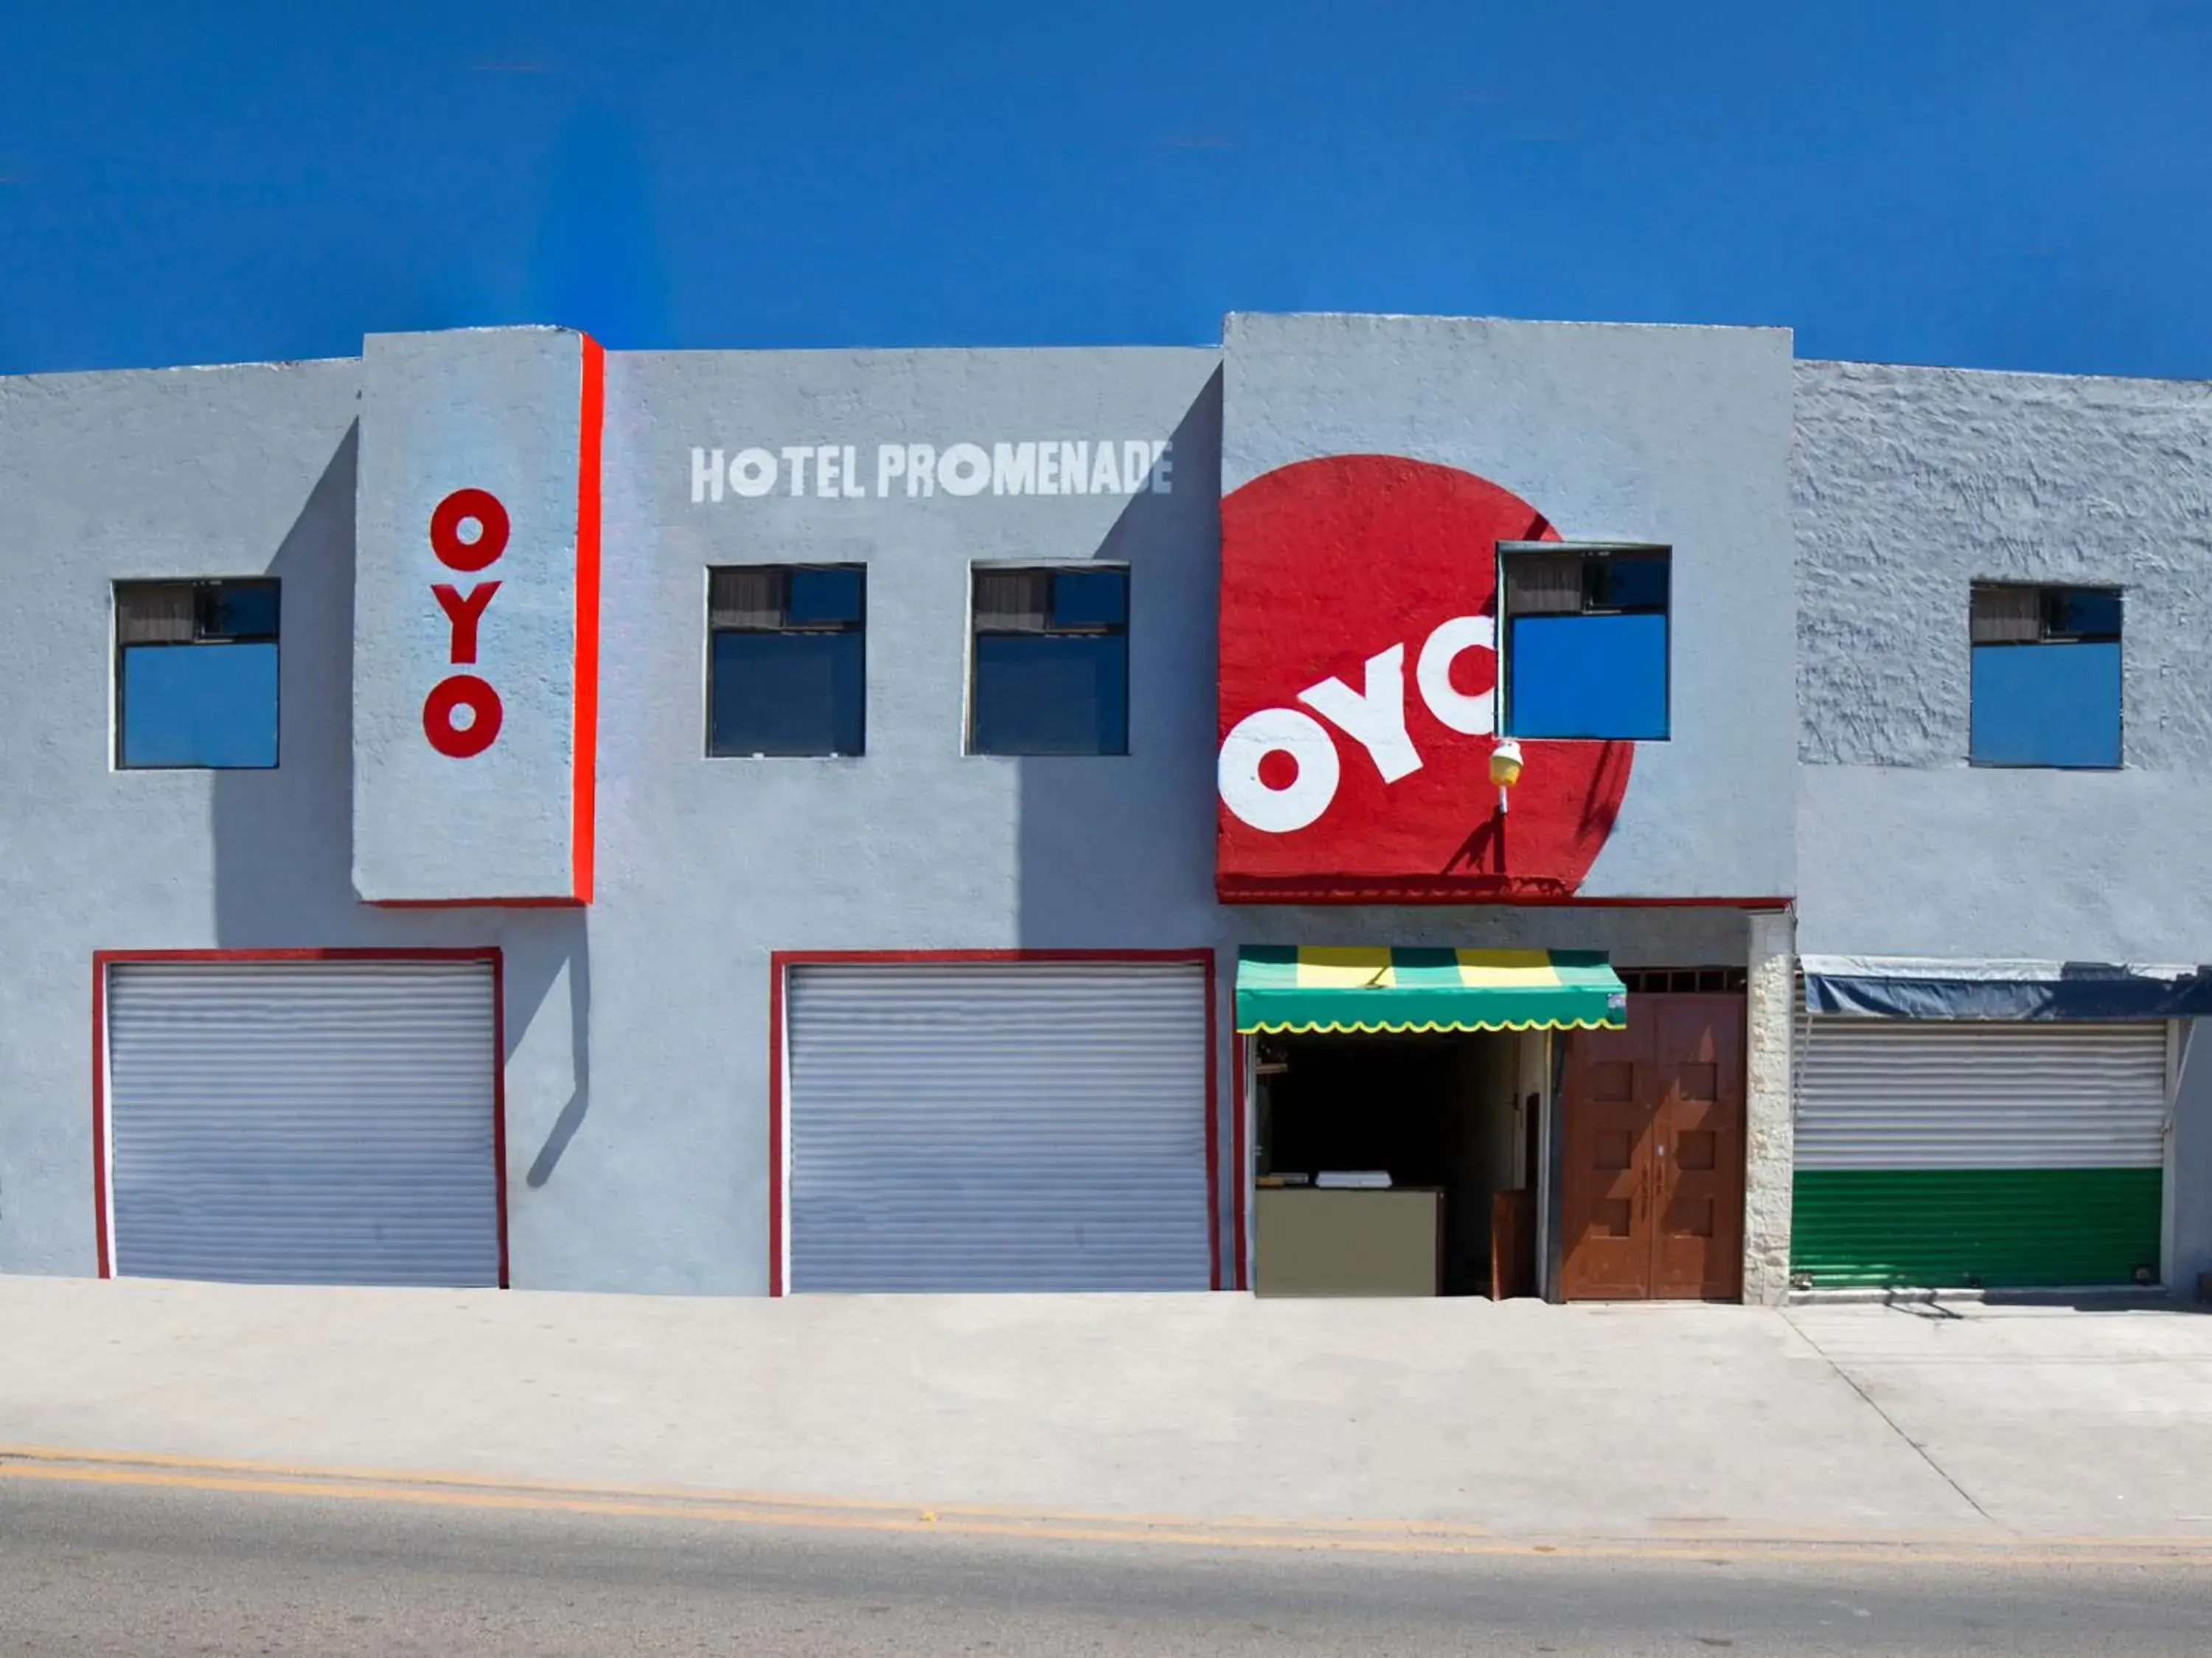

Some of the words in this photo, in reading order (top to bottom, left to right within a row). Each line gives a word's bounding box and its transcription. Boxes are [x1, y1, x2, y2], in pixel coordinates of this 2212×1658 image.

[691, 445, 864, 502] HOTEL
[877, 441, 1173, 498] PROMENADE
[422, 487, 510, 759] OYO
